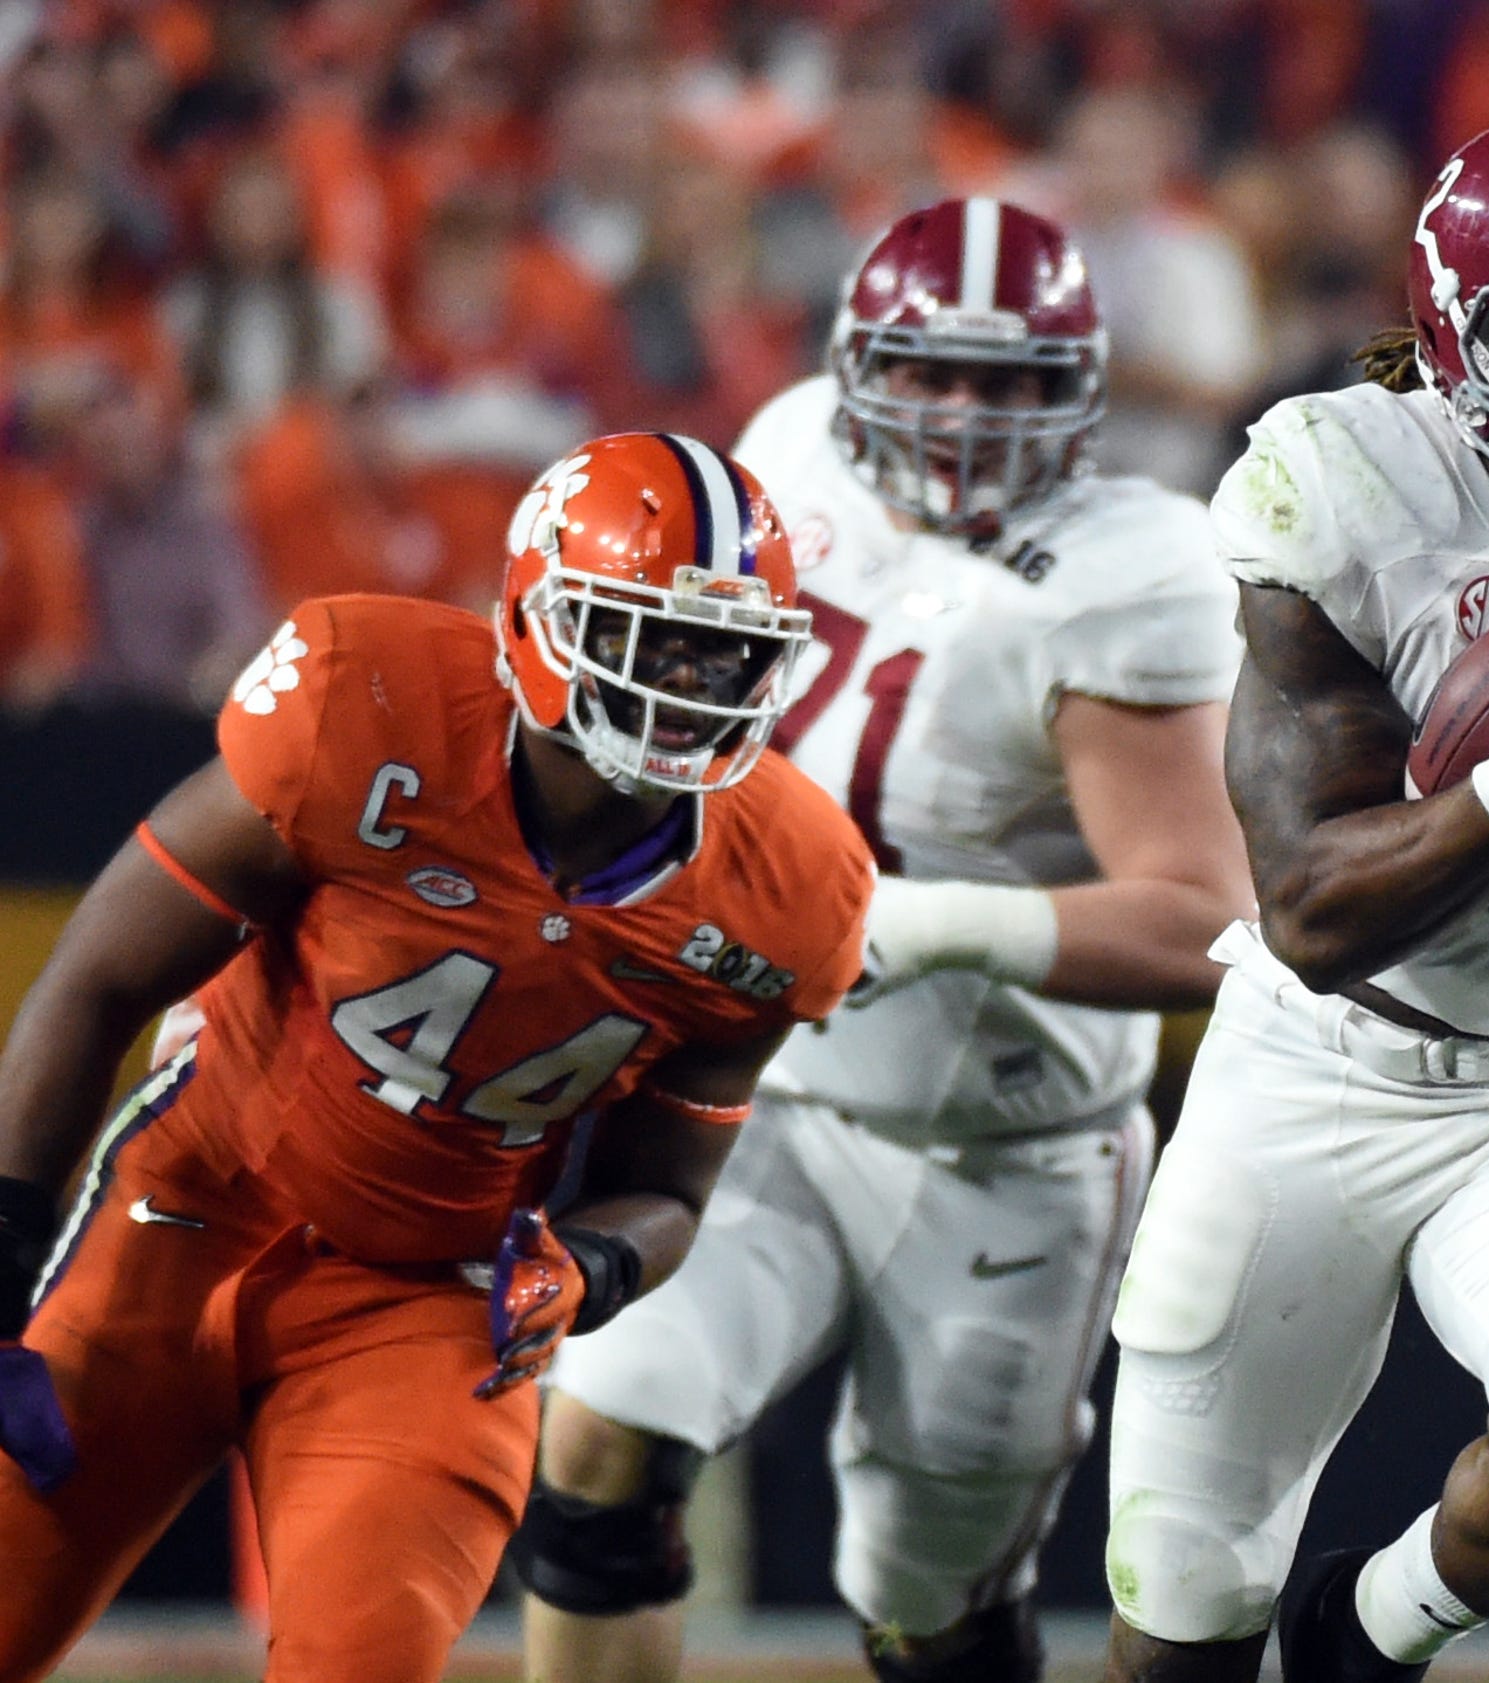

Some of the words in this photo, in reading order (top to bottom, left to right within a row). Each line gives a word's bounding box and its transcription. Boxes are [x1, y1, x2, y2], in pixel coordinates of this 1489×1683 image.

[775, 588, 926, 878] 71
[357, 762, 421, 850] C
[412, 874, 474, 900] ACC
[330, 948, 650, 1148] 44
